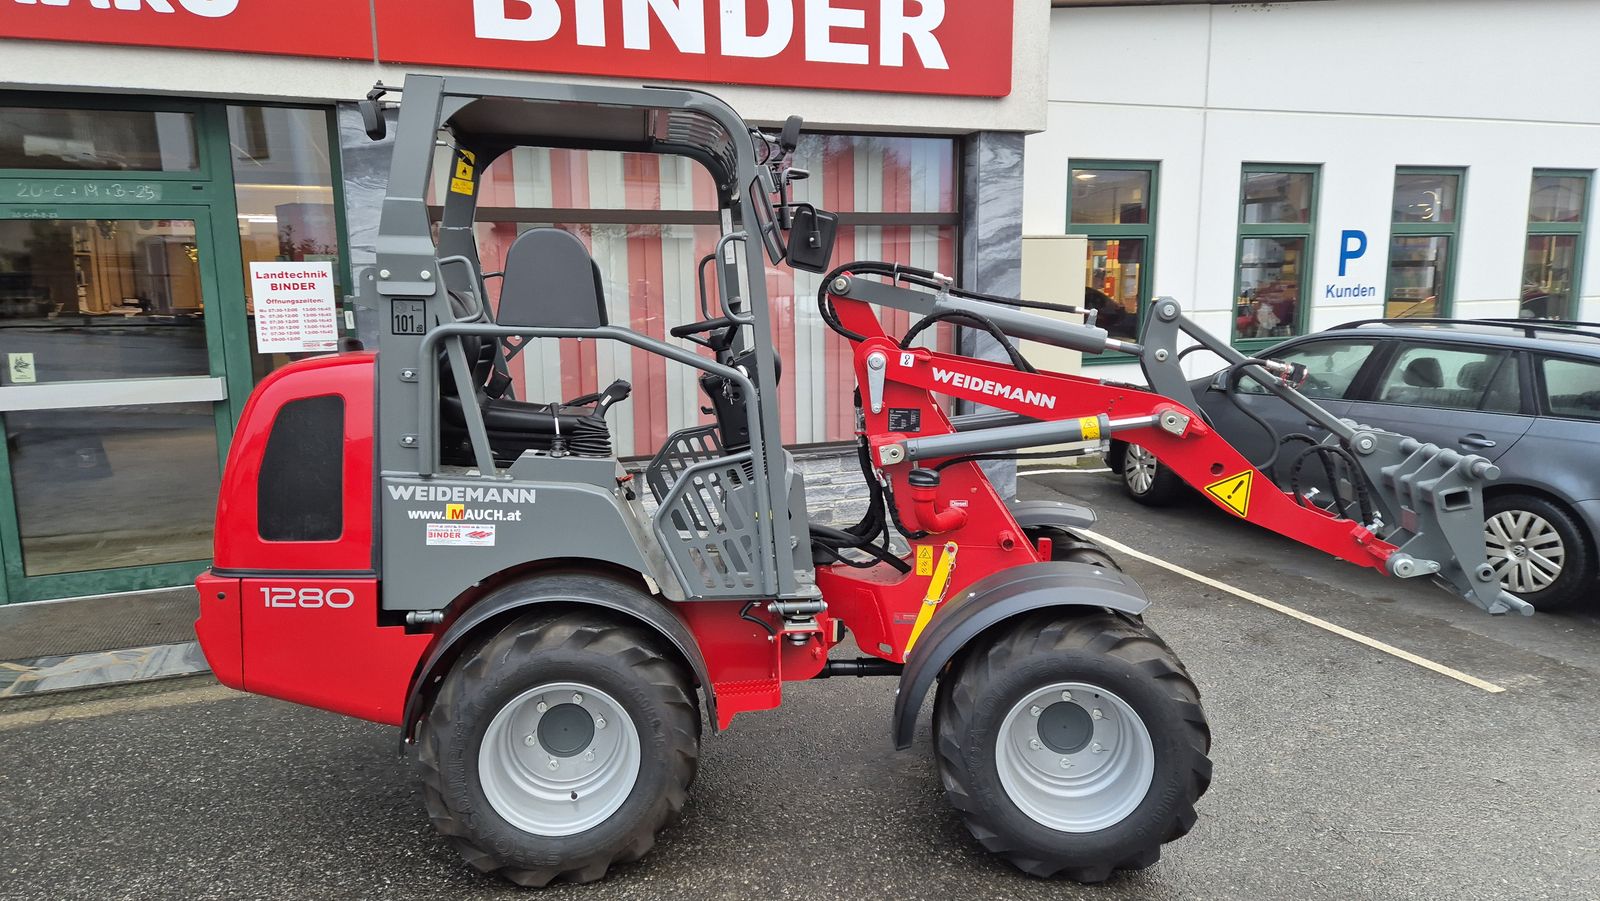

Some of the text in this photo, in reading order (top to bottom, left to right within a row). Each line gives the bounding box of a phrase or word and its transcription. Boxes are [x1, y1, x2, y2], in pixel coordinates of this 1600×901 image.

[1338, 229, 1368, 277] P
[255, 270, 328, 279] Landtechnik
[270, 282, 316, 291] BINDER
[1325, 283, 1376, 299] Kunden
[395, 314, 414, 332] 101
[932, 366, 1057, 410] WEIDEMANN
[387, 485, 536, 504] WEIDEMANN
[260, 587, 355, 609] 1280
